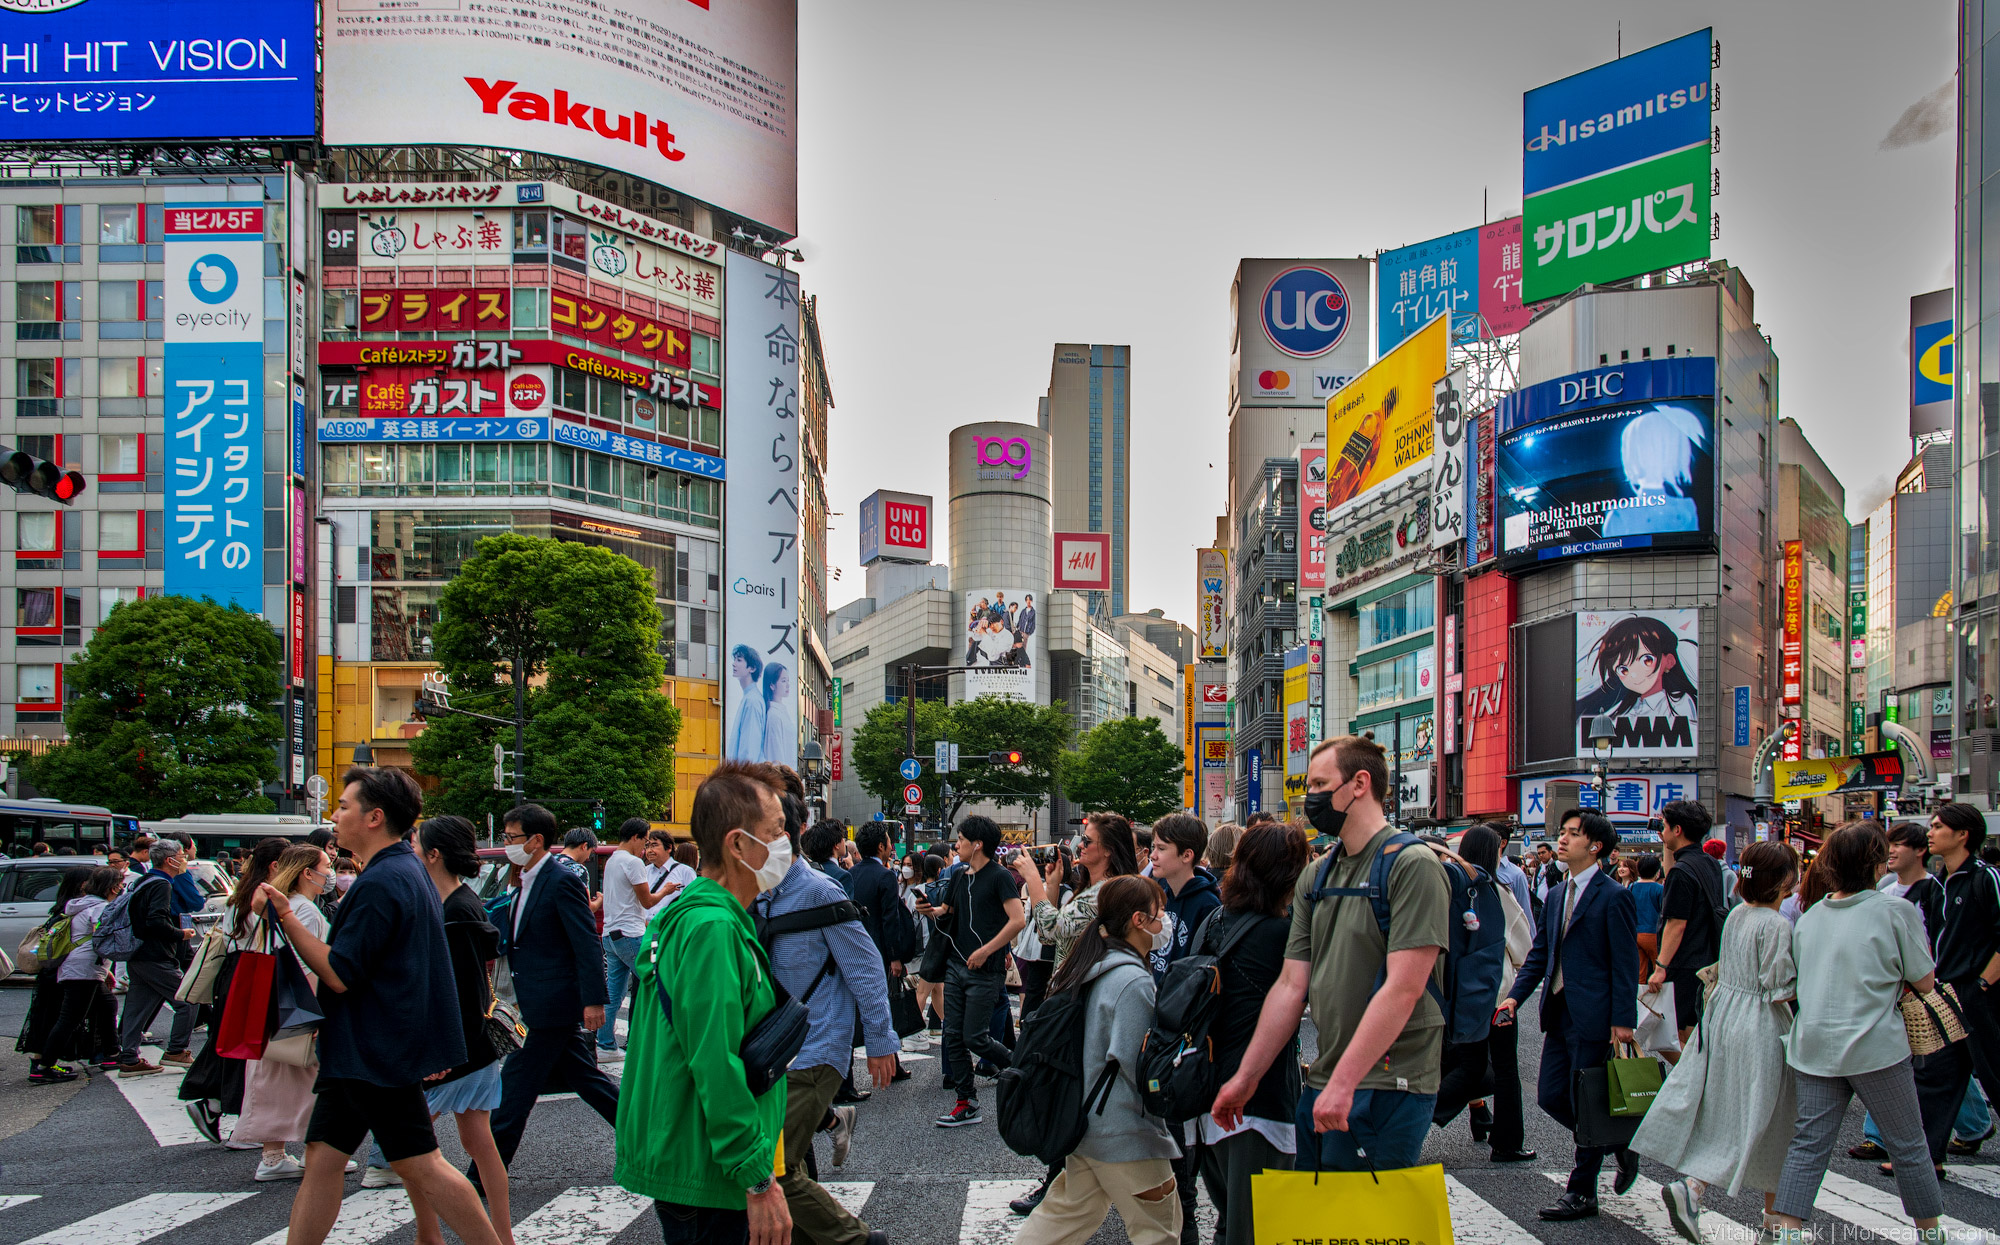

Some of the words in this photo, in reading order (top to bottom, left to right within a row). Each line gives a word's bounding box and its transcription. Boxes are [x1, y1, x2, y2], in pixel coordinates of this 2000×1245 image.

[64, 41, 128, 73] HIT
[149, 38, 287, 71] VISION
[464, 77, 686, 162] Yakult
[1526, 81, 1708, 152] Hisamitsu
[342, 185, 503, 205] しゃぶしゃぶバイキング
[519, 186, 542, 202] 寿司
[174, 211, 254, 231] 当ビル5F
[412, 220, 503, 251] しゃぶ葉
[576, 195, 718, 259] しゃぶしゃぶバイキング
[1534, 182, 1698, 267] サロンパス
[327, 229, 355, 248] 9F
[635, 250, 716, 301] しゃぶ葉
[1400, 258, 1459, 297] 龍角散
[176, 309, 252, 332] eyecity
[363, 292, 509, 324] プライス
[1391, 288, 1469, 327] ダイレクト
[552, 295, 687, 358] コンタクト
[451, 340, 524, 370] ガスト
[1058, 357, 1086, 365] INDIGO
[325, 385, 357, 406] 7F
[366, 384, 405, 401] Café
[408, 377, 497, 416] ガスト
[514, 390, 543, 401] ガスト
[648, 371, 711, 408] ガスト
[1316, 375, 1354, 390] VIS
[1559, 371, 1625, 406] DHC
[367, 398, 405, 411] レストラン
[324, 422, 368, 438] AEON
[382, 420, 511, 438] 英会話イーオン
[519, 423, 540, 436] 6F
[1395, 418, 1434, 454] JOHNNI
[561, 424, 602, 447] AEON
[610, 435, 723, 474] 英会話イーオン
[764, 268, 799, 656] 本命ならペアーズ
[1394, 436, 1433, 468] WALKE
[1436, 377, 1462, 537] もんじゃ
[175, 379, 216, 570] アイシティ
[221, 379, 251, 570] コンタクトの
[890, 507, 919, 526] UNI
[1540, 525, 1550, 534] EP
[890, 525, 922, 544] QLO
[1544, 533, 1554, 541] on
[1555, 530, 1571, 540] sale
[1562, 545, 1583, 555] DHC
[1584, 539, 1623, 552] Channel
[1068, 551, 1097, 571] H&M
[746, 582, 775, 599] pairs
[1787, 544, 1799, 636] クスリのことなら
[1784, 641, 1801, 698] 三千里
[833, 750, 841, 771] アコム
[1527, 781, 1685, 818] 大堂書店
